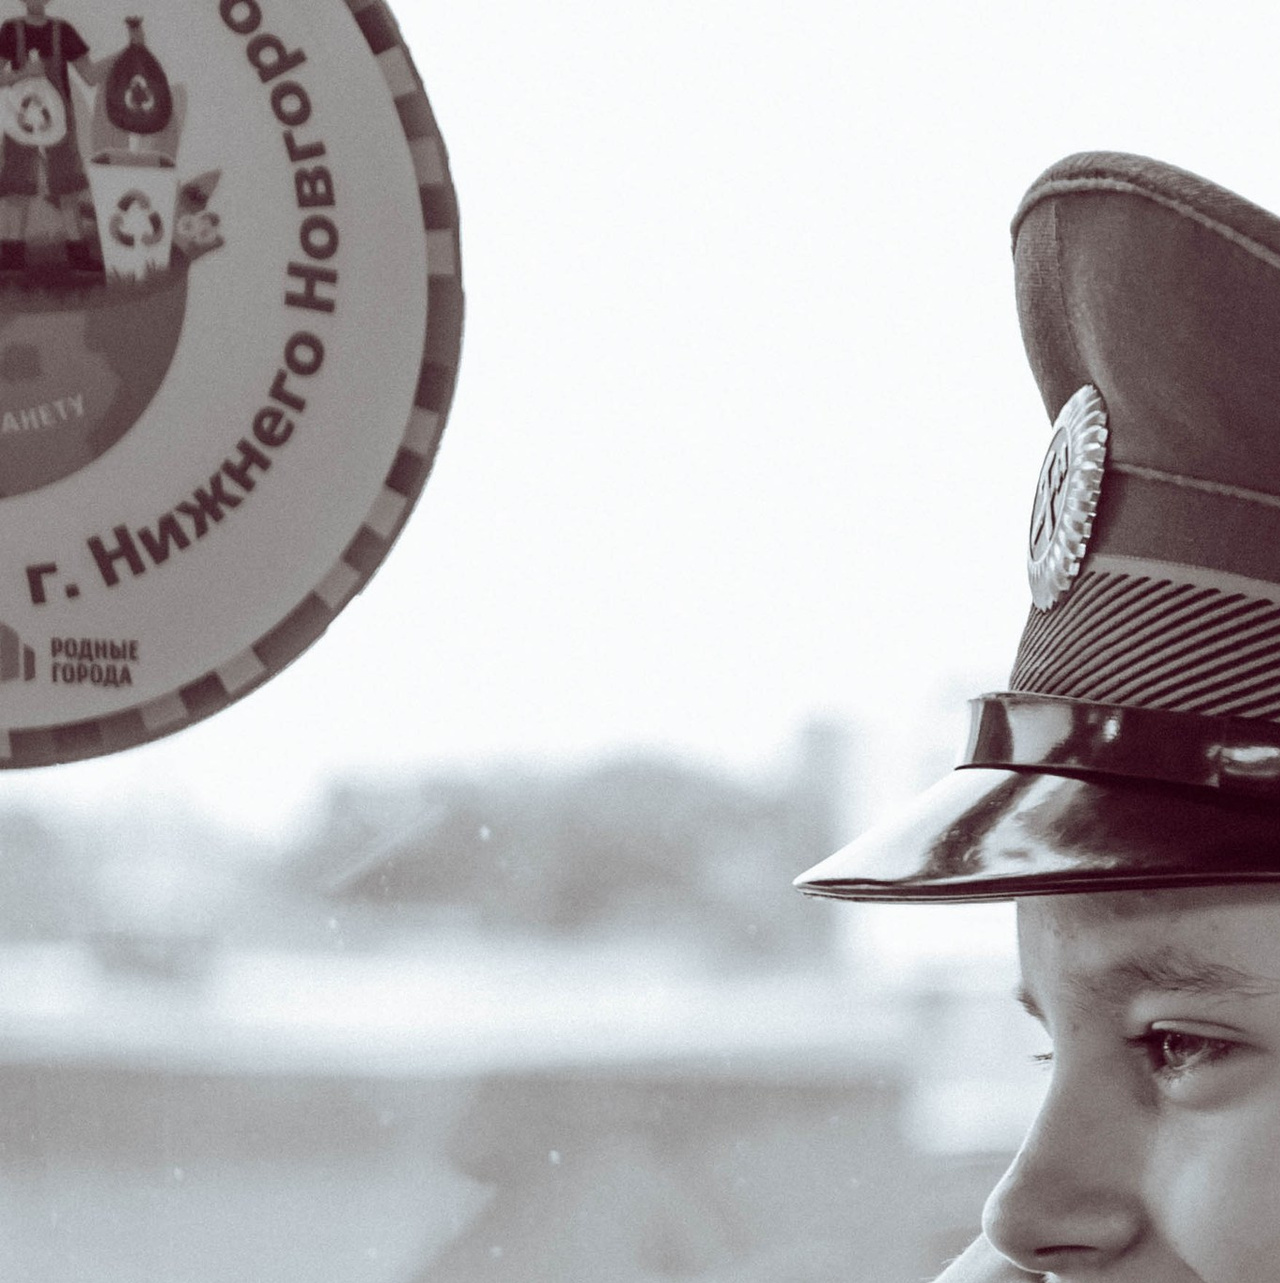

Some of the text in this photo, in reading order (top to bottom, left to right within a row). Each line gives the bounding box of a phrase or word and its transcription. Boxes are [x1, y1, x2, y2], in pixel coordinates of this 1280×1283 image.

[26, 0, 340, 605] г. Нижнего Новгоро
[51, 636, 139, 662] РОДНЫЕ
[52, 662, 132, 687] ГОРОДА
